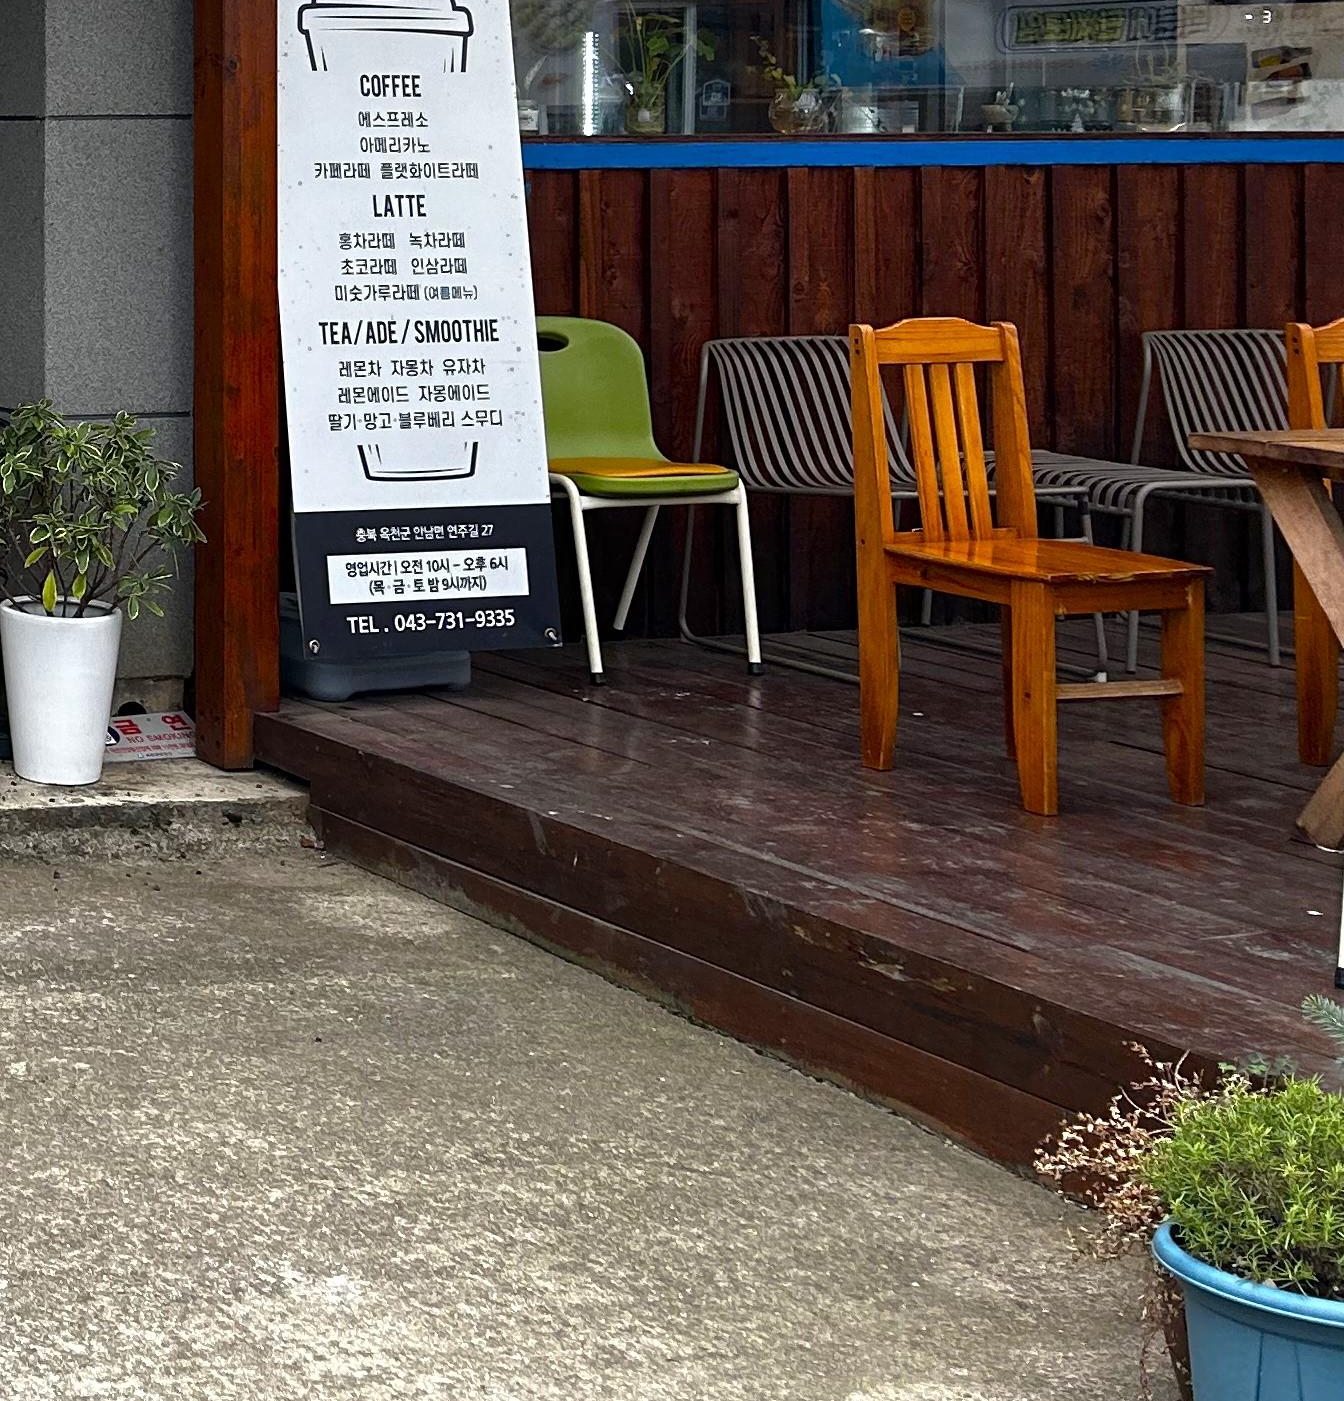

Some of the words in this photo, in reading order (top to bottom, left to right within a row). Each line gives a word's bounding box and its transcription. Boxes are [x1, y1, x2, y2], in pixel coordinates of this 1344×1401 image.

[360, 74, 422, 98] COFFEE
[358, 111, 429, 128] 에스프레소
[360, 136, 431, 154] 아메리카노
[314, 162, 371, 180] 카페라떼
[380, 162, 480, 180] 플랫화이트라떼
[372, 194, 427, 218] LATTE
[338, 232, 396, 250] 홍차라떼
[409, 231, 466, 249] 녹차라떼
[341, 258, 398, 276] 초코라떼
[411, 257, 468, 275] 인삼라떼
[334, 284, 420, 302] 미숫가루라떼
[338, 360, 382, 378] 레몬차
[390, 359, 434, 377] 자몽차
[442, 358, 486, 376] 유자차
[337, 385, 410, 404] 레몬에이드
[418, 384, 491, 403] 자몽에이드
[461, 409, 503, 428] 스무디
[355, 527, 378, 543] 충북
[379, 526, 411, 542] 옥천군
[413, 525, 445, 540] 안남면
[446, 523, 479, 539] 연주길
[481, 524, 494, 537] 27
[345, 560, 392, 578] 영업시간
[400, 559, 424, 575] 오전
[426, 557, 450, 573] 10시
[462, 556, 487, 572] 오후
[489, 555, 509, 571] 6시
[427, 576, 439, 593] 밤
[441, 575, 487, 592] 9시까지)
[394, 608, 515, 633] 043-731-9335
[126, 736, 144, 744] NO
[146, 731, 193, 742] SMOKIN
